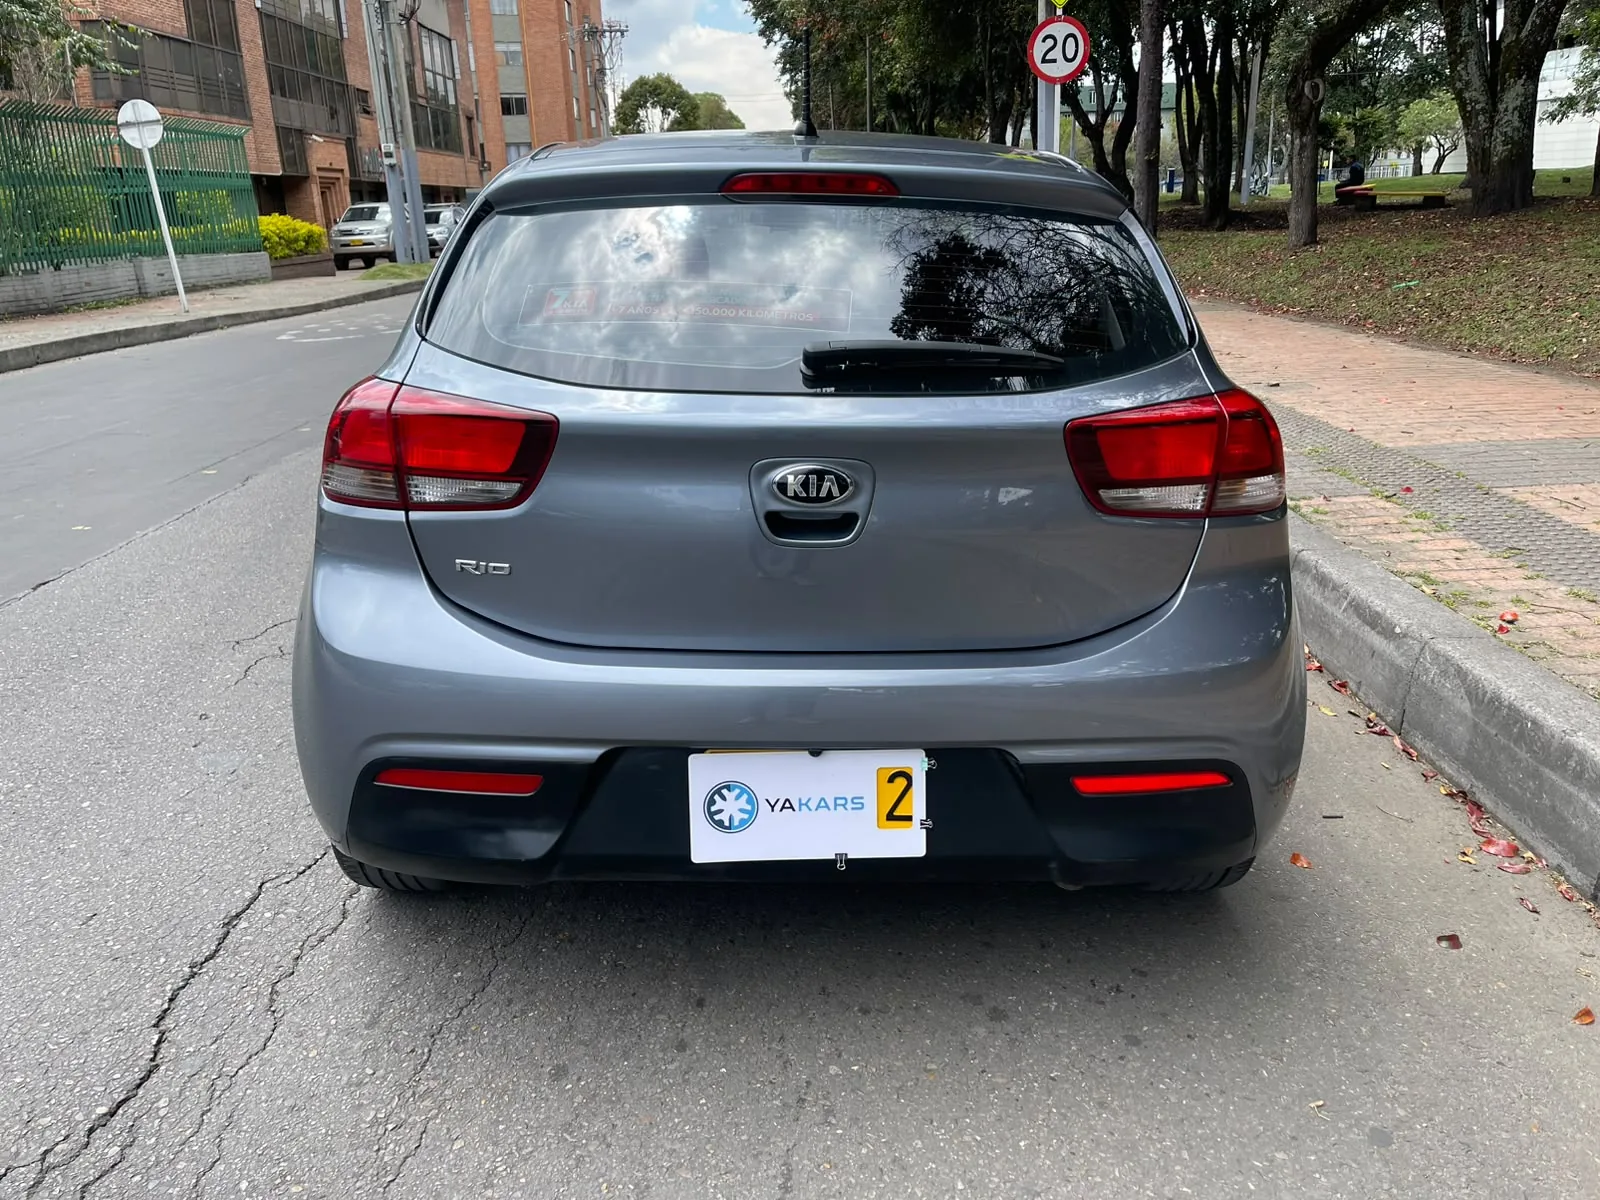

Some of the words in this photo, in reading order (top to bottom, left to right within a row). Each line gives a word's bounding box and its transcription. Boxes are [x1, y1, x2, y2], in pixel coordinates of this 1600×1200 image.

[1040, 33, 1079, 64] 20
[786, 474, 840, 497] KIA
[455, 558, 511, 575] RIO
[765, 796, 865, 813] YAKARS
[885, 769, 913, 822] 2
